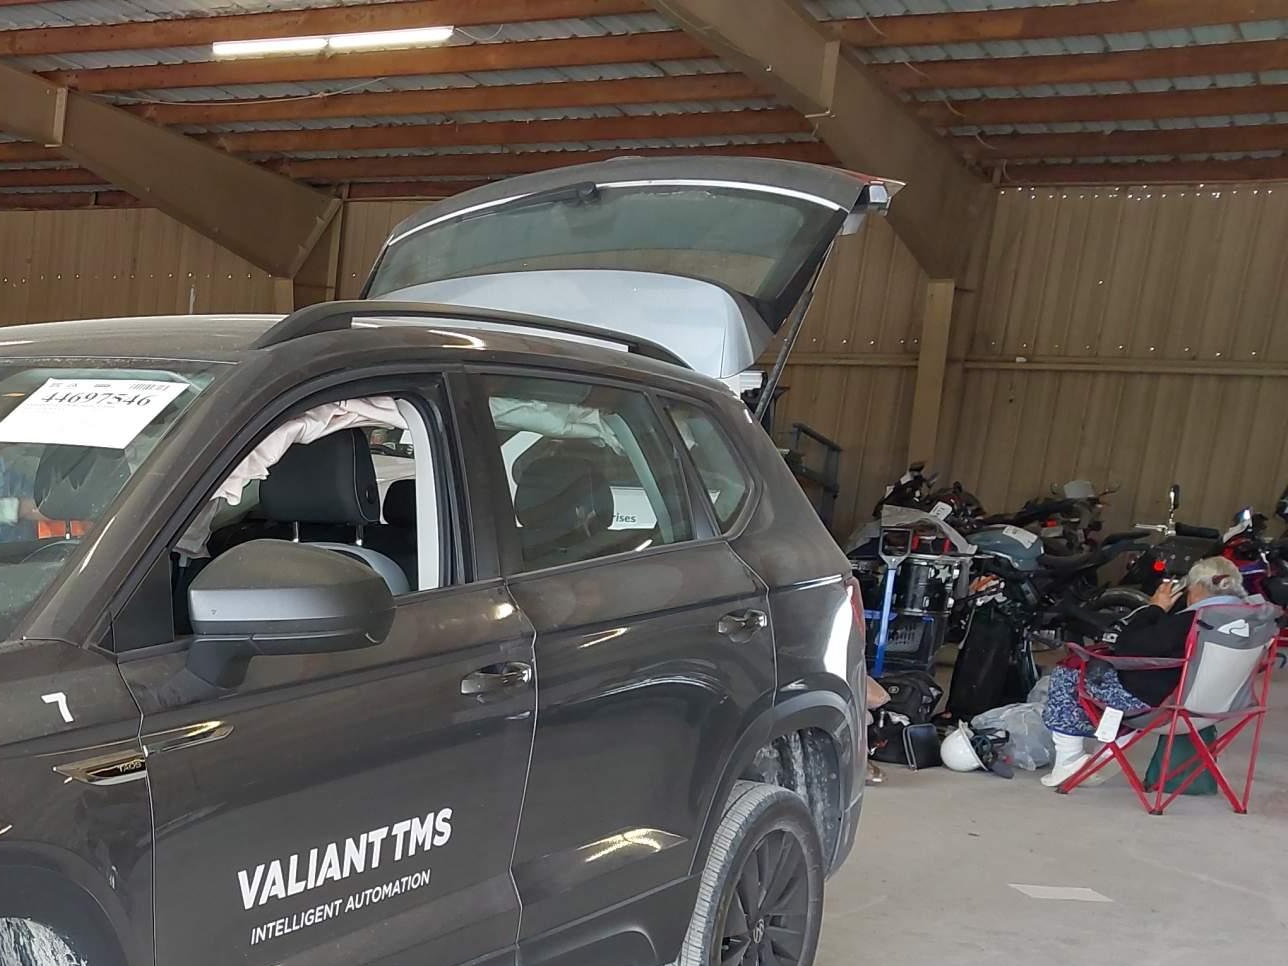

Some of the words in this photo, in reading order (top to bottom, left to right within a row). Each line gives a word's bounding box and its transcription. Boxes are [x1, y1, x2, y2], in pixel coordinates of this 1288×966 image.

[41, 392, 154, 406] 44697546
[41, 692, 74, 723] 7
[119, 761, 142, 774] TAOS
[237, 826, 389, 910] VALIANT
[391, 807, 453, 862] TMS
[250, 899, 342, 945] INTELLIGENT
[345, 869, 431, 912] AUTOMATION
